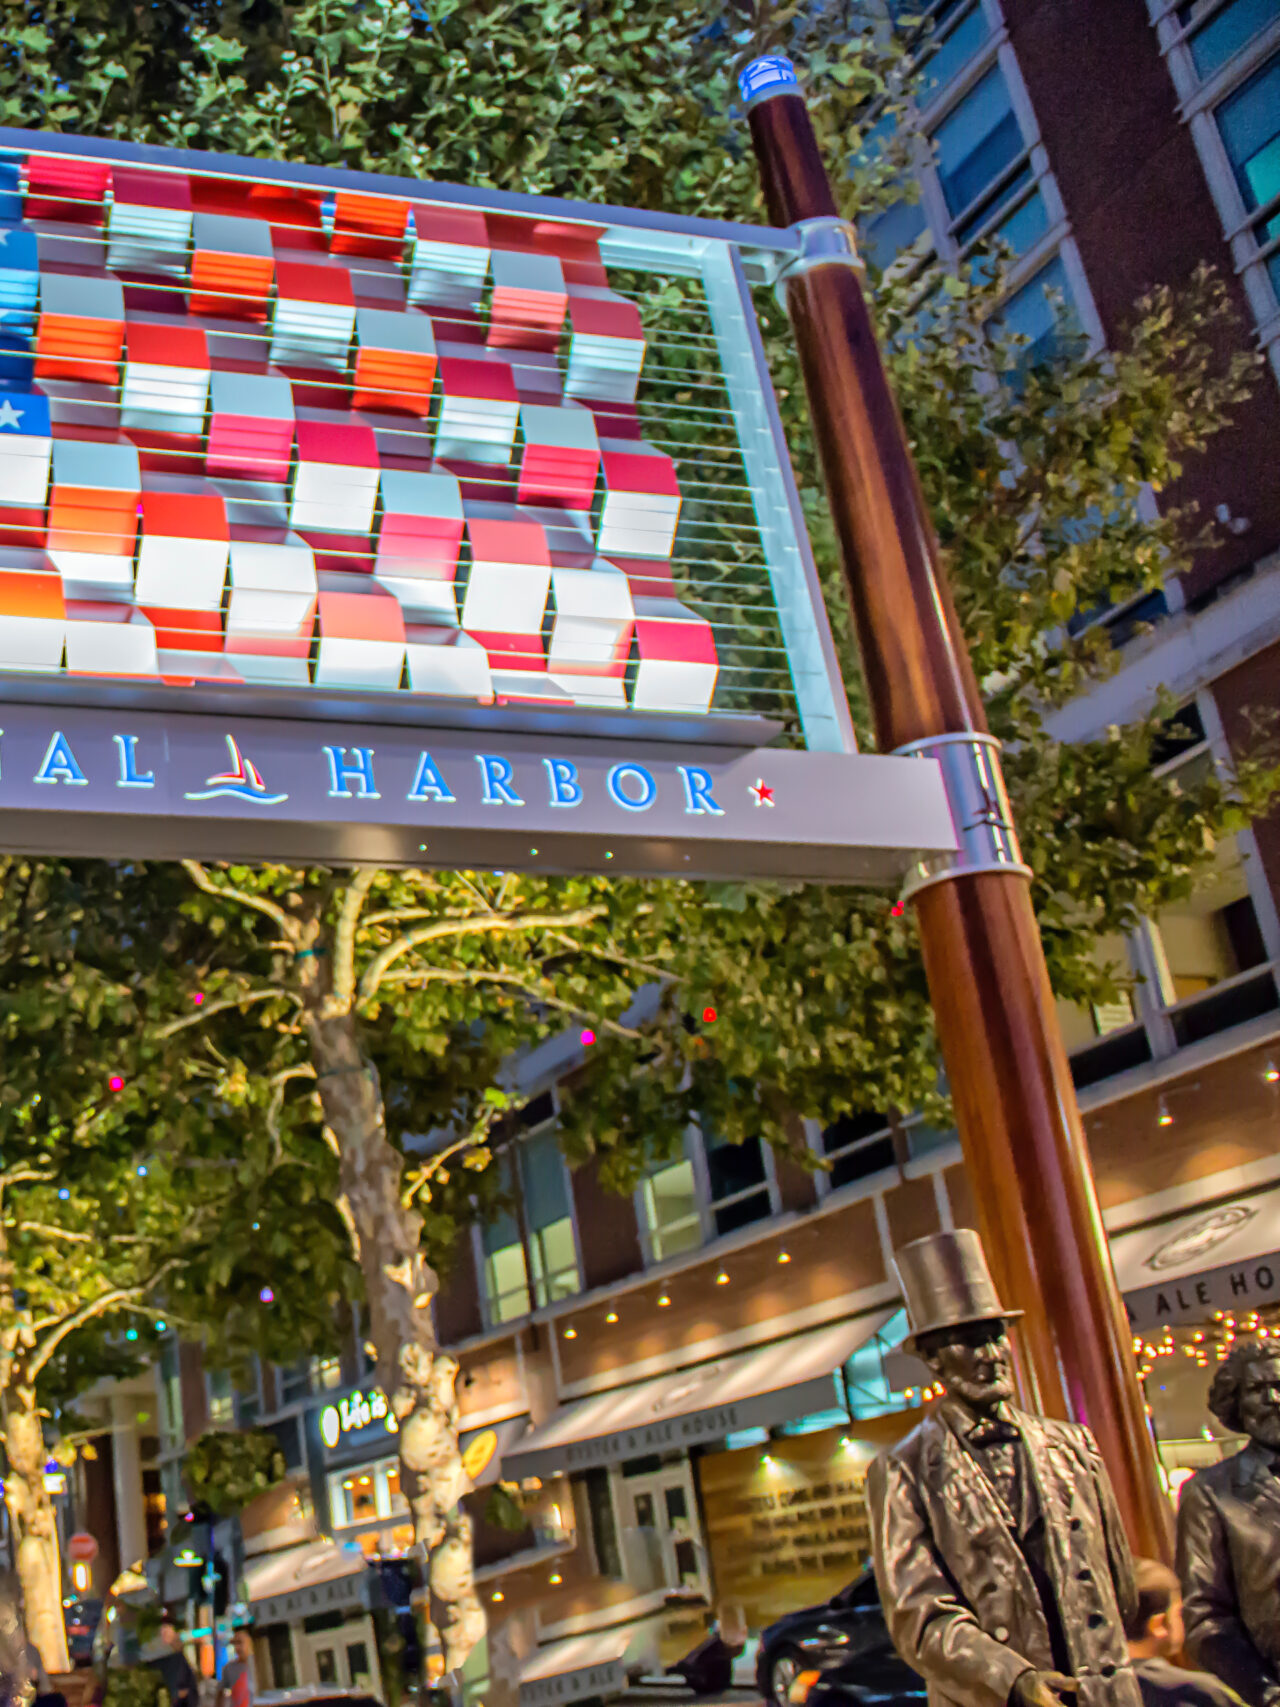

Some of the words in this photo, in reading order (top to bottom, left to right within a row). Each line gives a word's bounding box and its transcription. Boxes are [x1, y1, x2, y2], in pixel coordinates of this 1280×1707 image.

[322, 745, 724, 816] HARBOR
[1157, 1281, 1211, 1316] ALE
[645, 1423, 672, 1444] ALE
[682, 1407, 737, 1435] HOUSE
